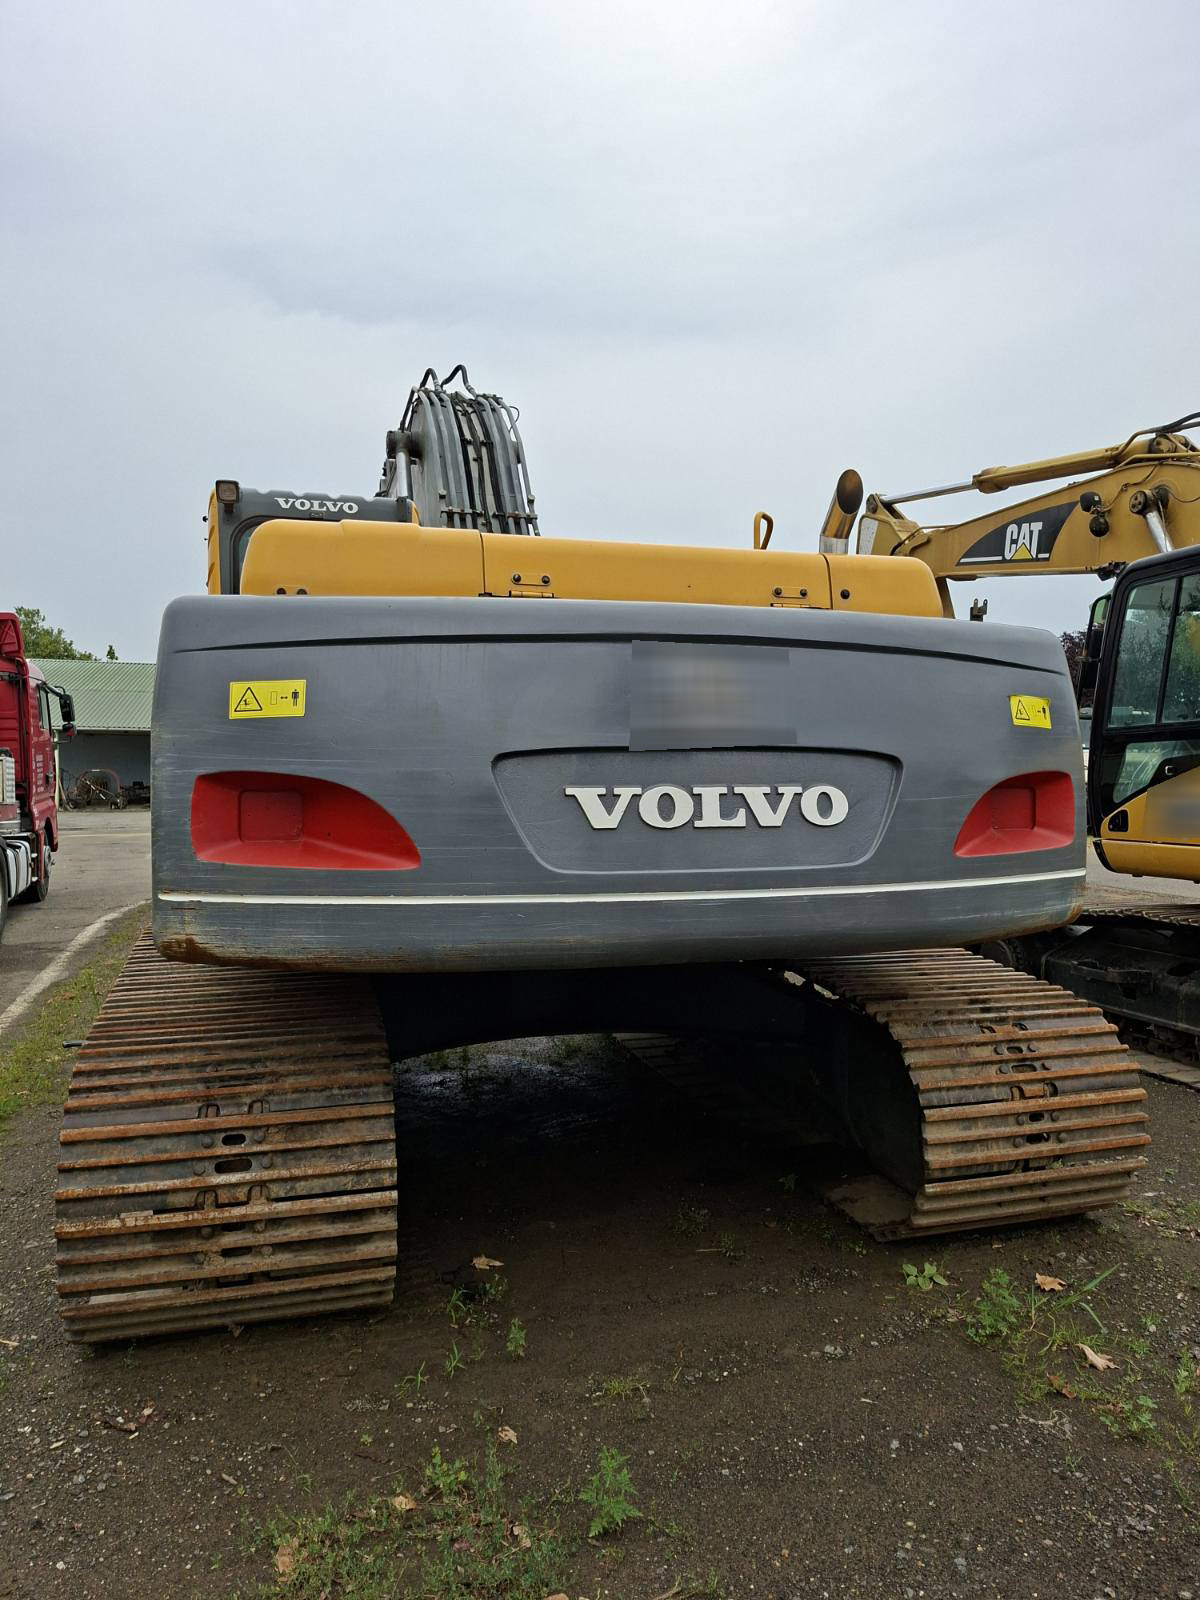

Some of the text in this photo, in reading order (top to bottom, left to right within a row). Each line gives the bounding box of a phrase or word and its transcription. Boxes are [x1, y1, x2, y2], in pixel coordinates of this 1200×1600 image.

[274, 497, 359, 514] VOLVO
[1004, 521, 1043, 560] CAT
[565, 785, 849, 829] VOLVO
